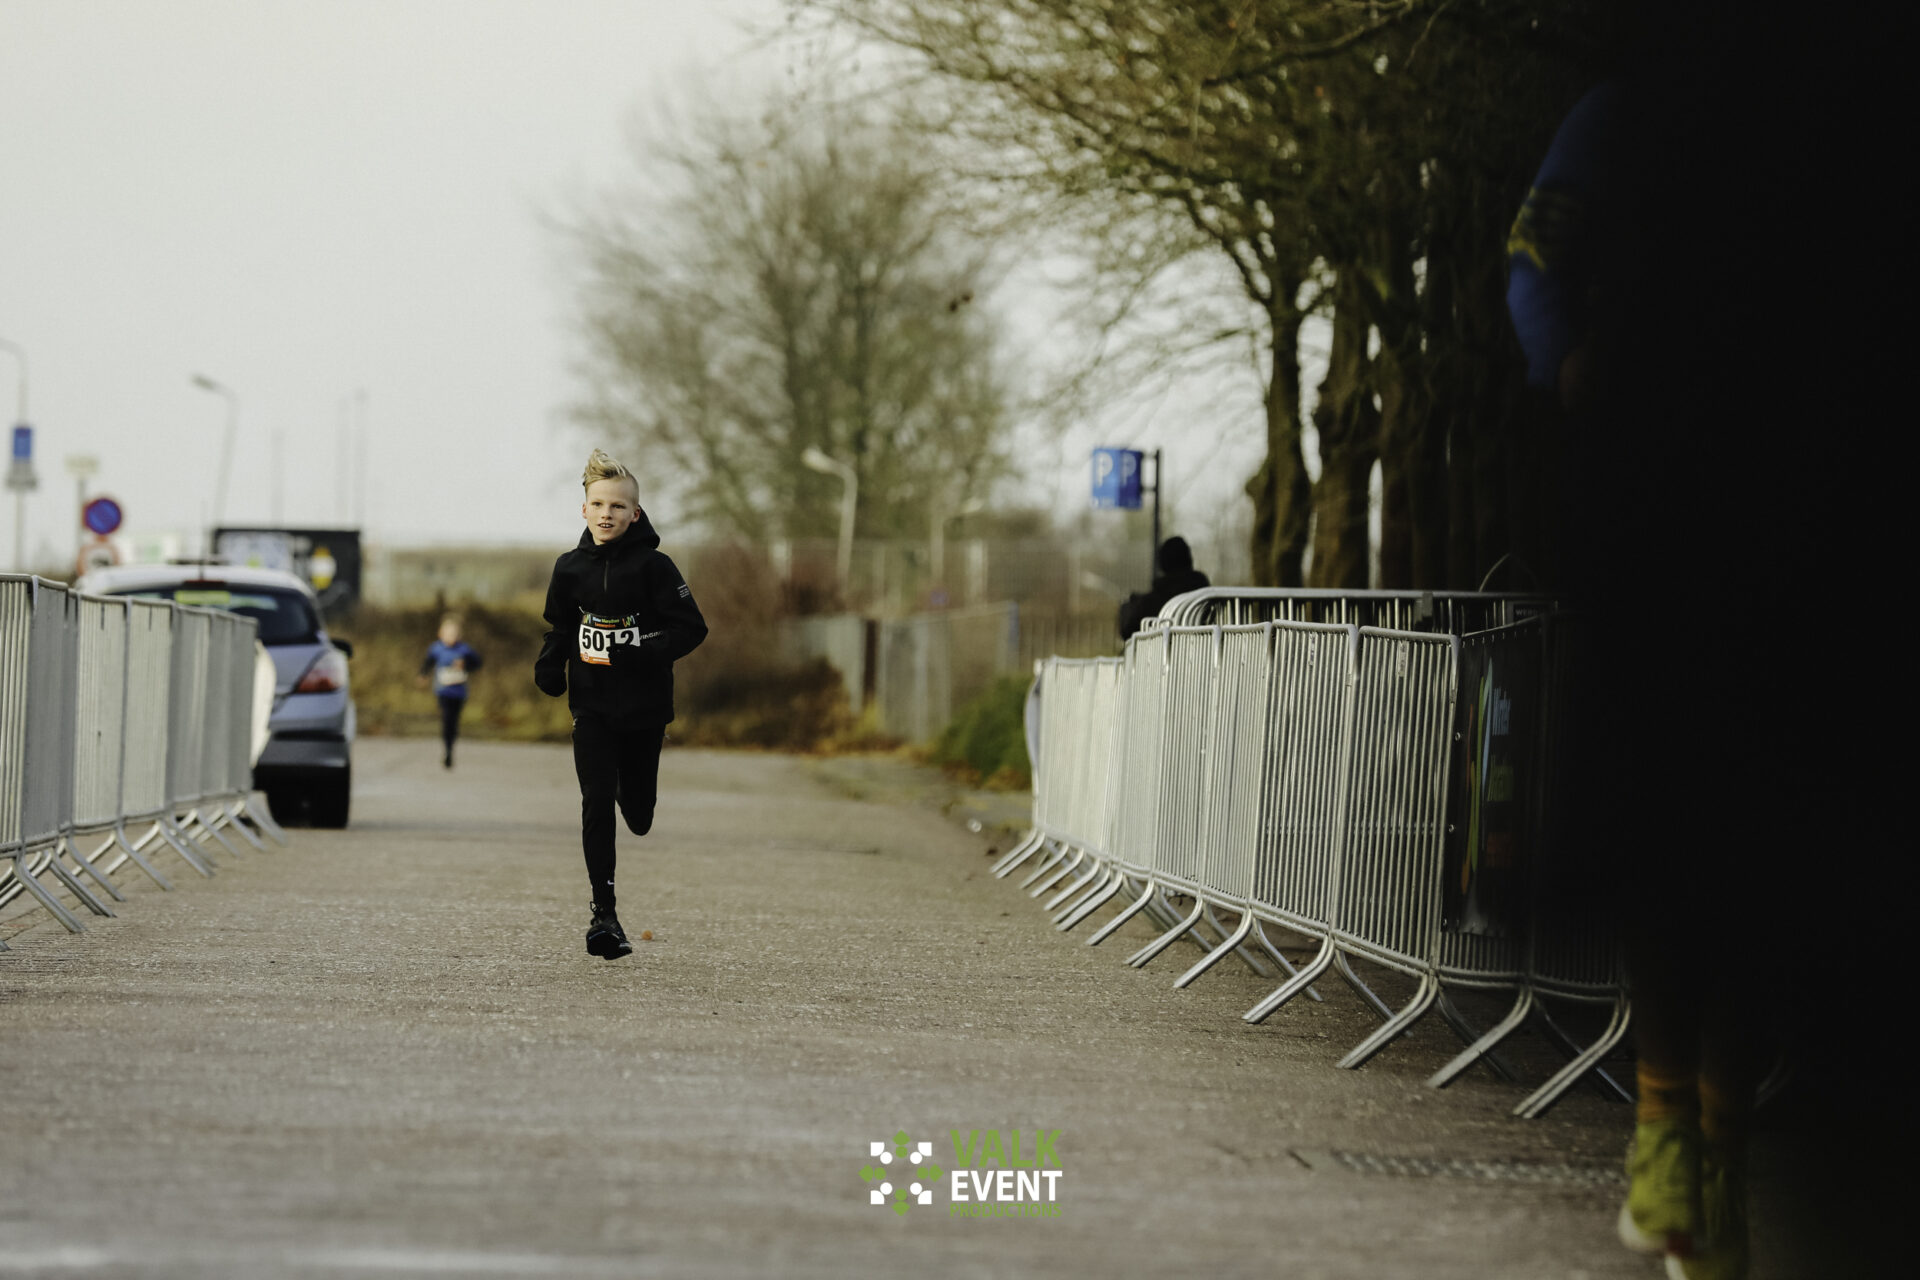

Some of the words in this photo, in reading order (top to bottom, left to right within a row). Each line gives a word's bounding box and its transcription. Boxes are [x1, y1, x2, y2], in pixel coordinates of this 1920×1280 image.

[1095, 451, 1113, 487] P
[1121, 452, 1136, 486] P
[582, 628, 634, 652] 5012
